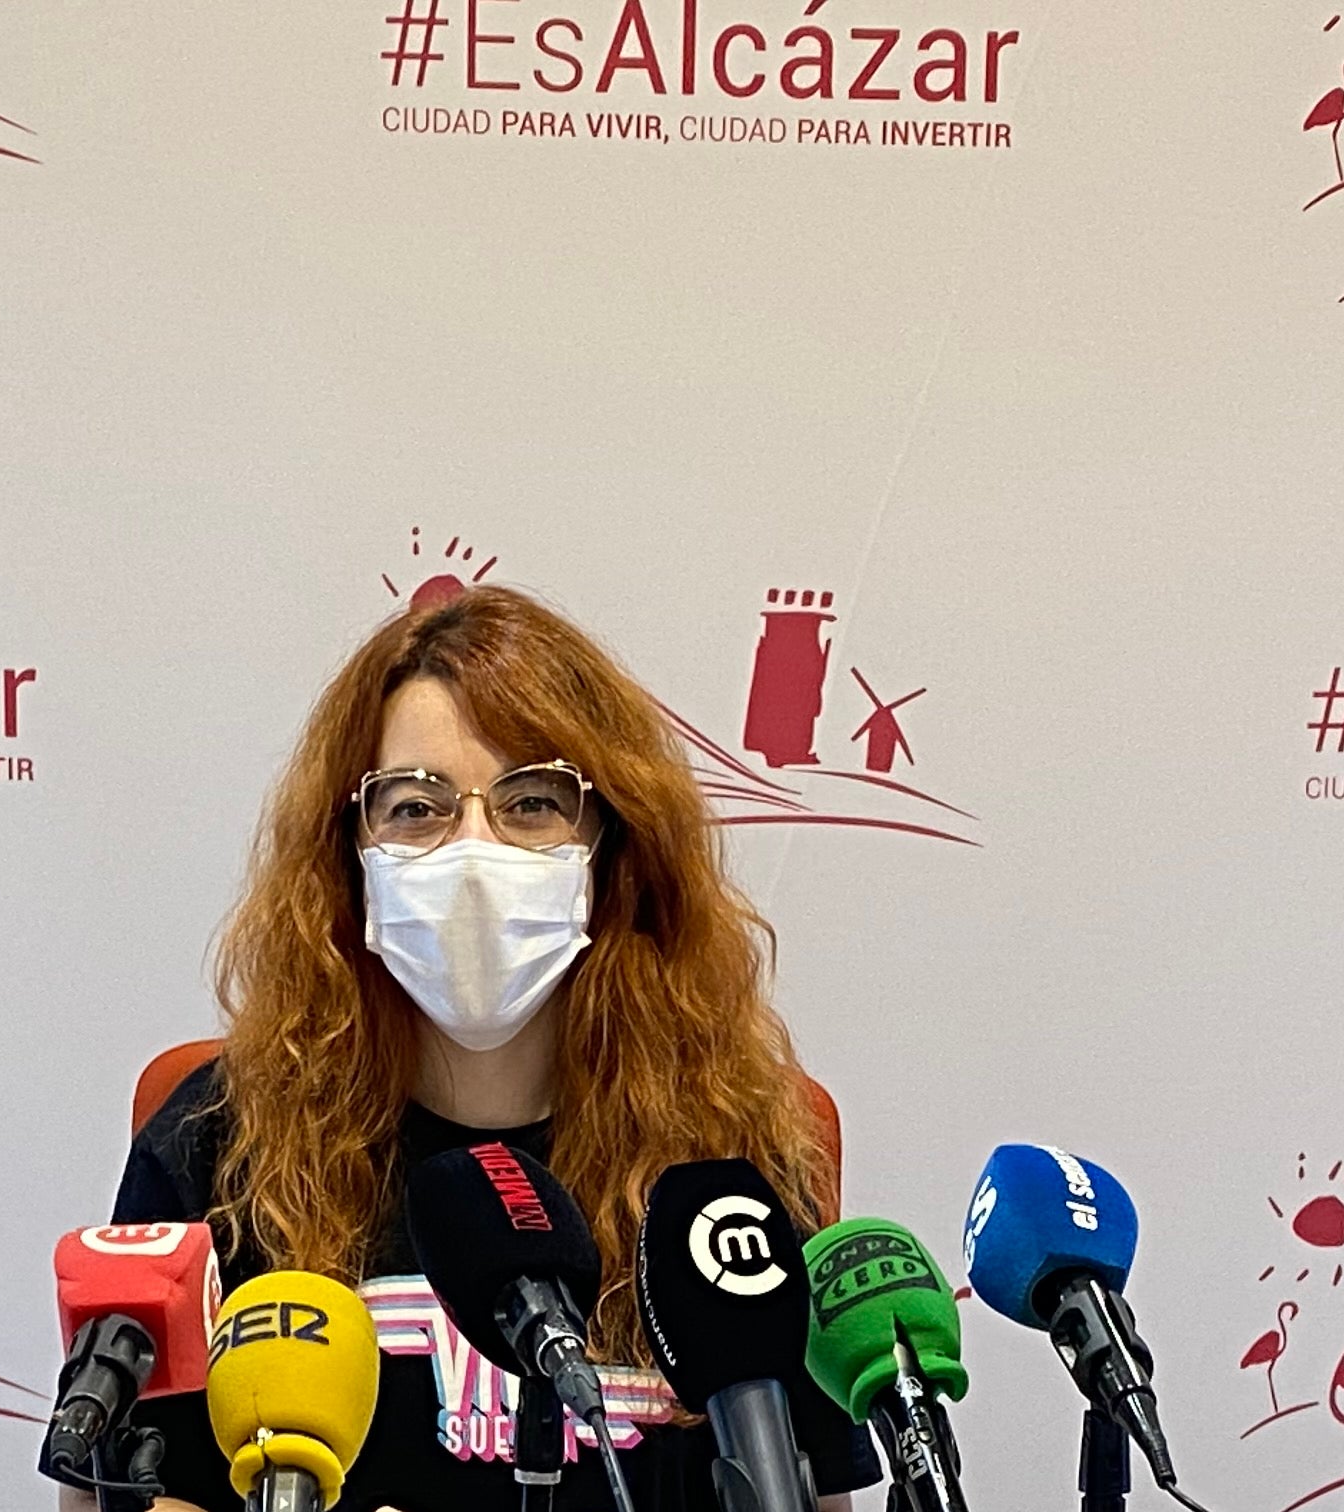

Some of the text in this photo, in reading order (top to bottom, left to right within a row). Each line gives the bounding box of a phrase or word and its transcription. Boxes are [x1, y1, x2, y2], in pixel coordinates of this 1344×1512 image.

[381, 0, 1020, 103] #EsAlcázar
[382, 107, 1012, 148] CIUDAD PARA VIVIR, CIUDAD PARA INVERTIR
[206, 1302, 330, 1378] SER
